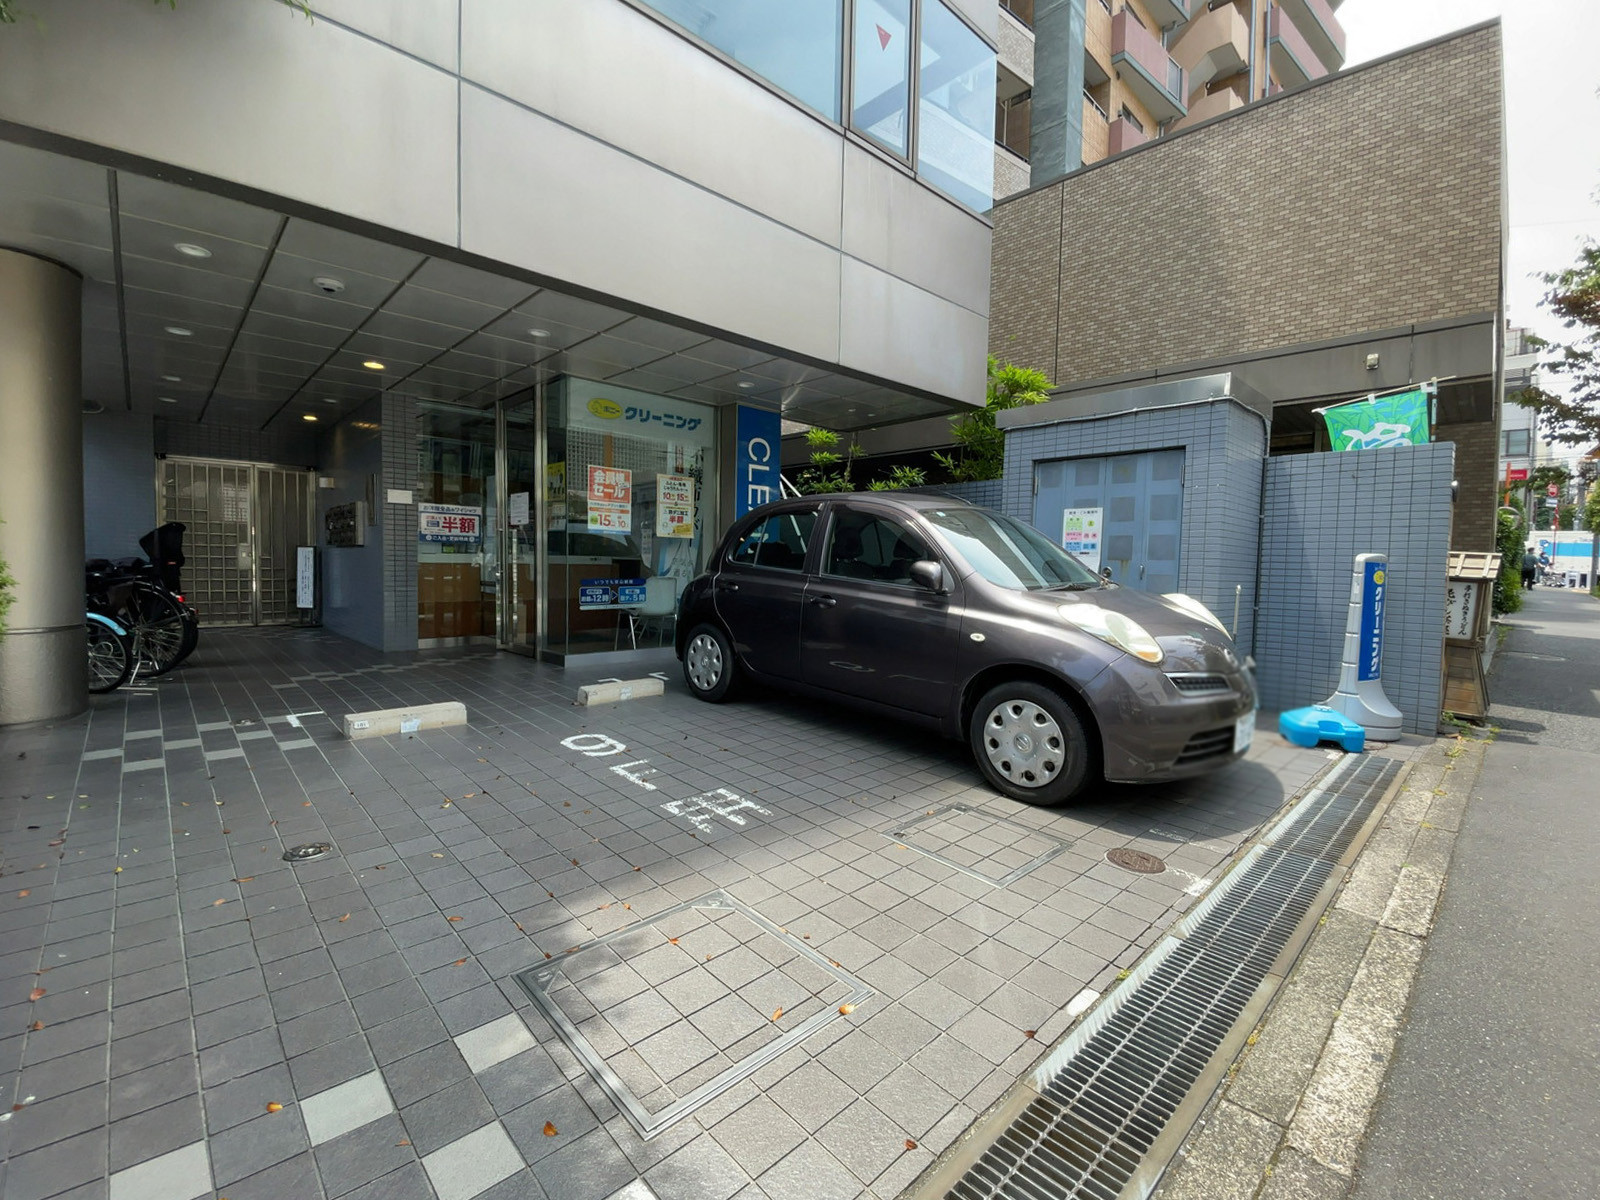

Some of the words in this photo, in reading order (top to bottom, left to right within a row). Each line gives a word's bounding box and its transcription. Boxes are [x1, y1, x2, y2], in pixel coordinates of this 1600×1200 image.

[625, 406, 702, 431] クリーニング
[748, 437, 771, 511] CLE
[593, 484, 625, 498] セール
[441, 516, 476, 534] 半額
[597, 513, 612, 527] 15
[1371, 586, 1383, 673] クリーニング
